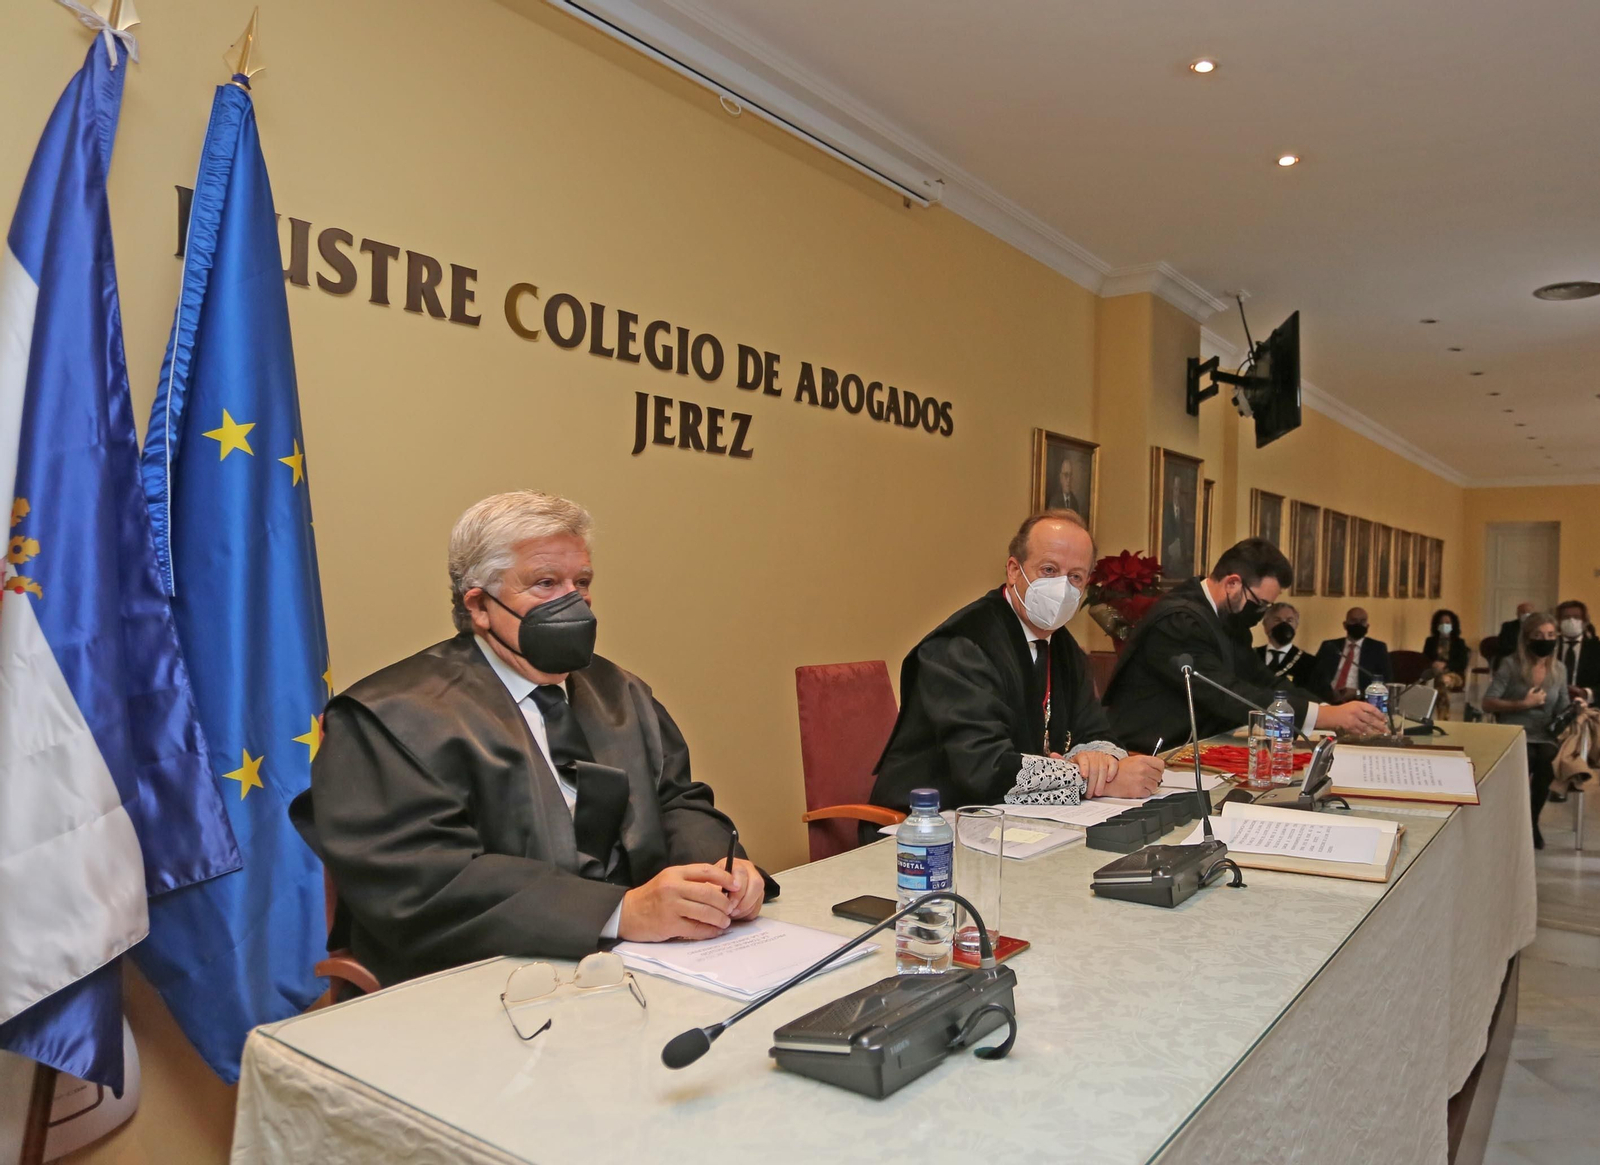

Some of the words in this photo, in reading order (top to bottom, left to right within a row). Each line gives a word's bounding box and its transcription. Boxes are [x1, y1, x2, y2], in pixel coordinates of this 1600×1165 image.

[175, 184, 482, 326] IUSTRE
[504, 283, 725, 381] COLEGIO
[736, 343, 783, 397] DE
[794, 361, 954, 437] ABOGADOS
[631, 391, 754, 458] JEREZ
